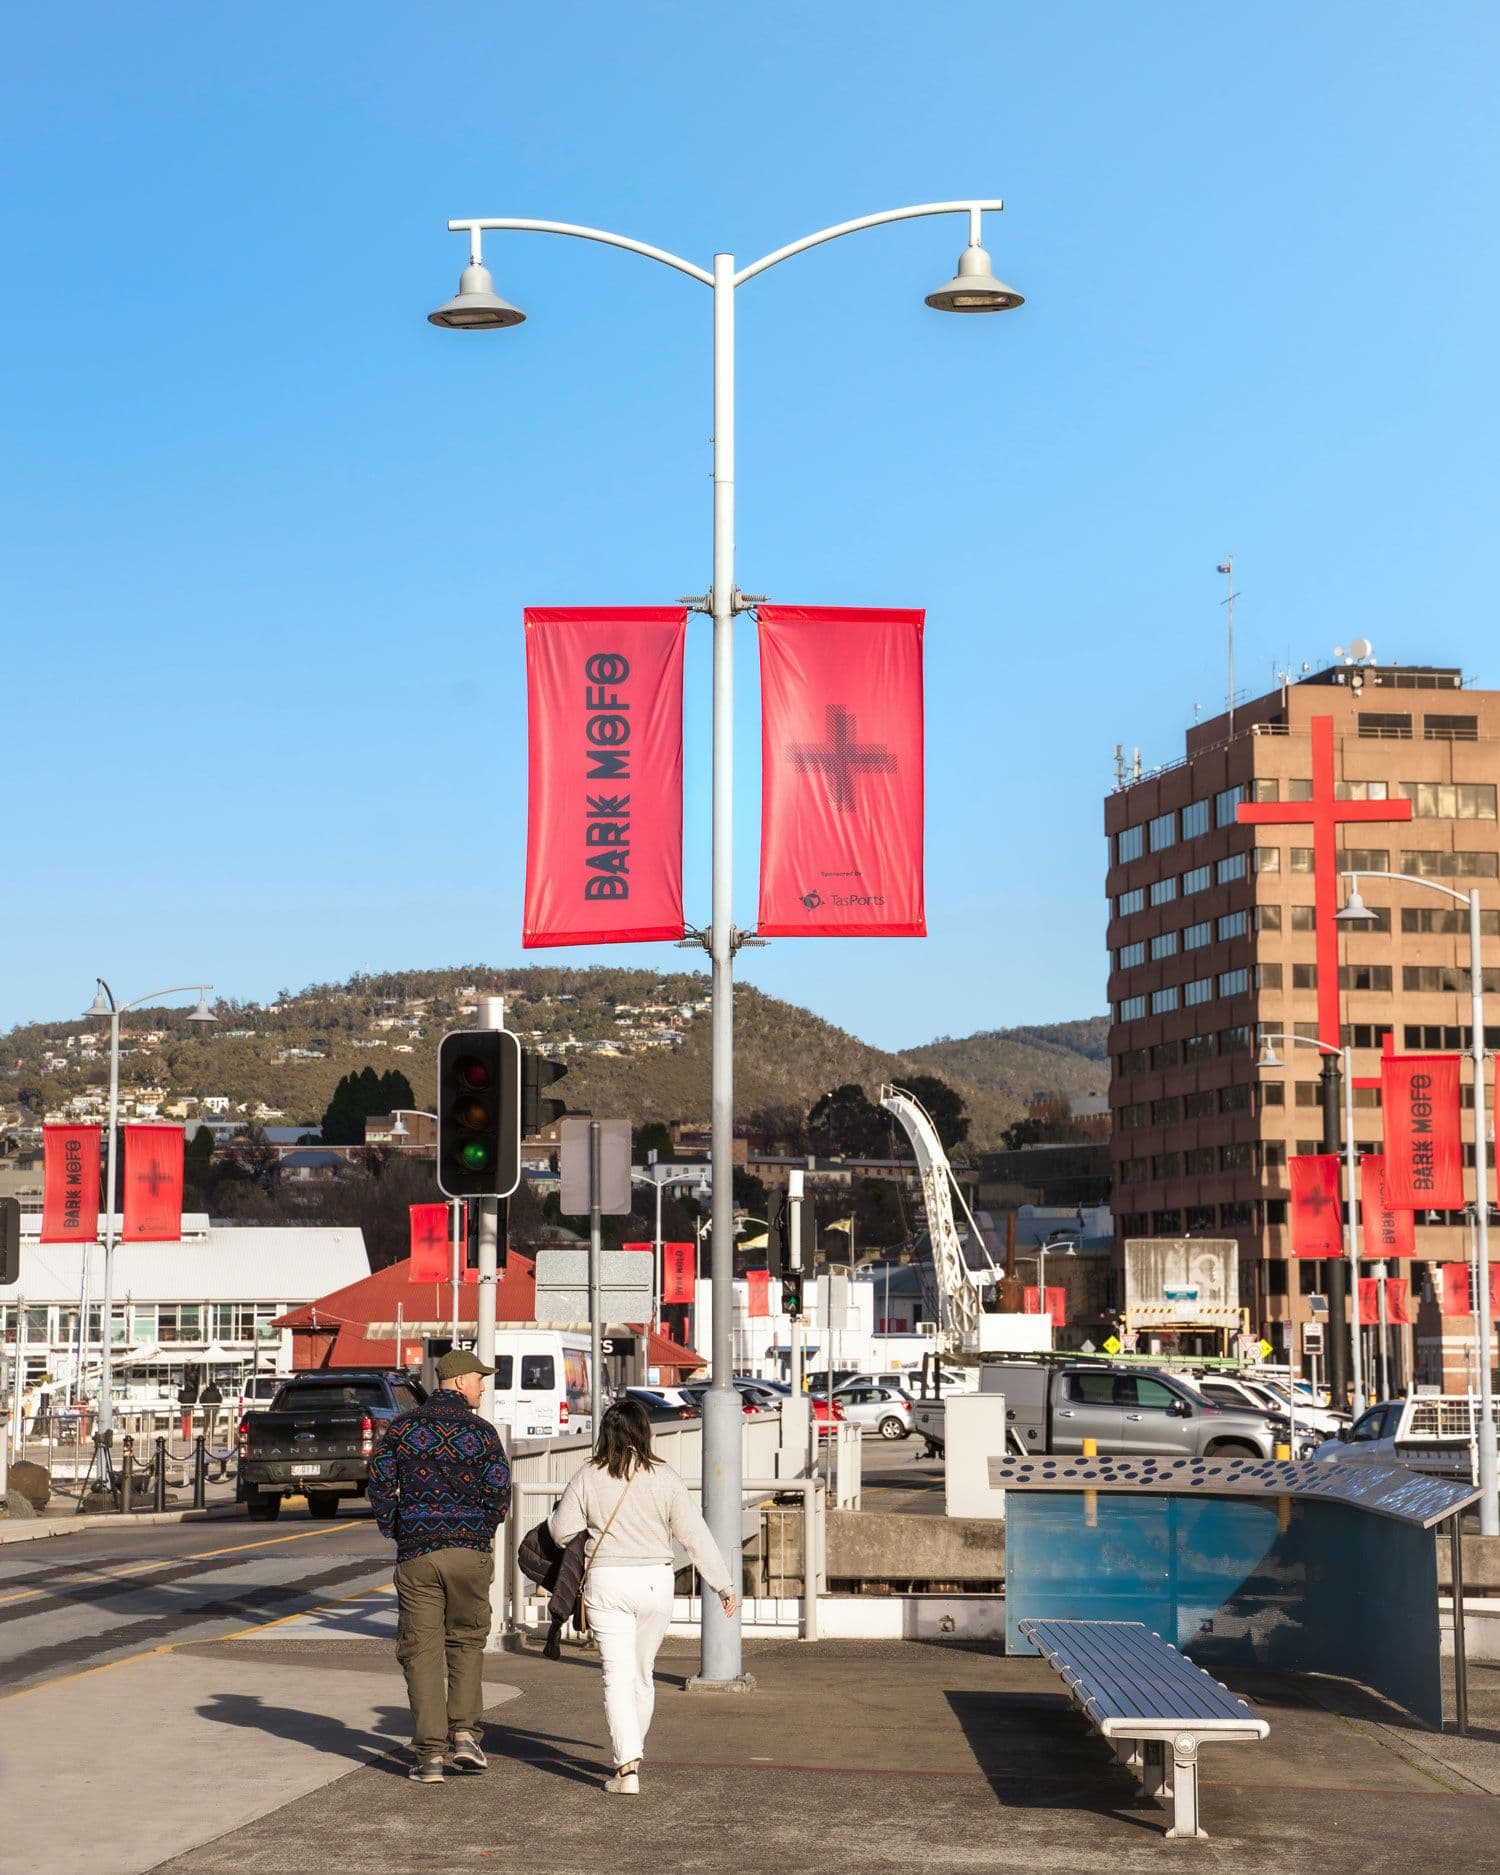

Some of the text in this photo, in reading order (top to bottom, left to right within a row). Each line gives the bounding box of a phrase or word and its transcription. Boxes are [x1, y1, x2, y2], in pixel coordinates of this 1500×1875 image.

[584, 653, 631, 901] DARK MOFO
[831, 894, 885, 906] TasPorts
[1410, 1074, 1434, 1190] DARK MOFO
[64, 1140, 82, 1228] DARK MOFO
[253, 1445, 357, 1455] RANGER
